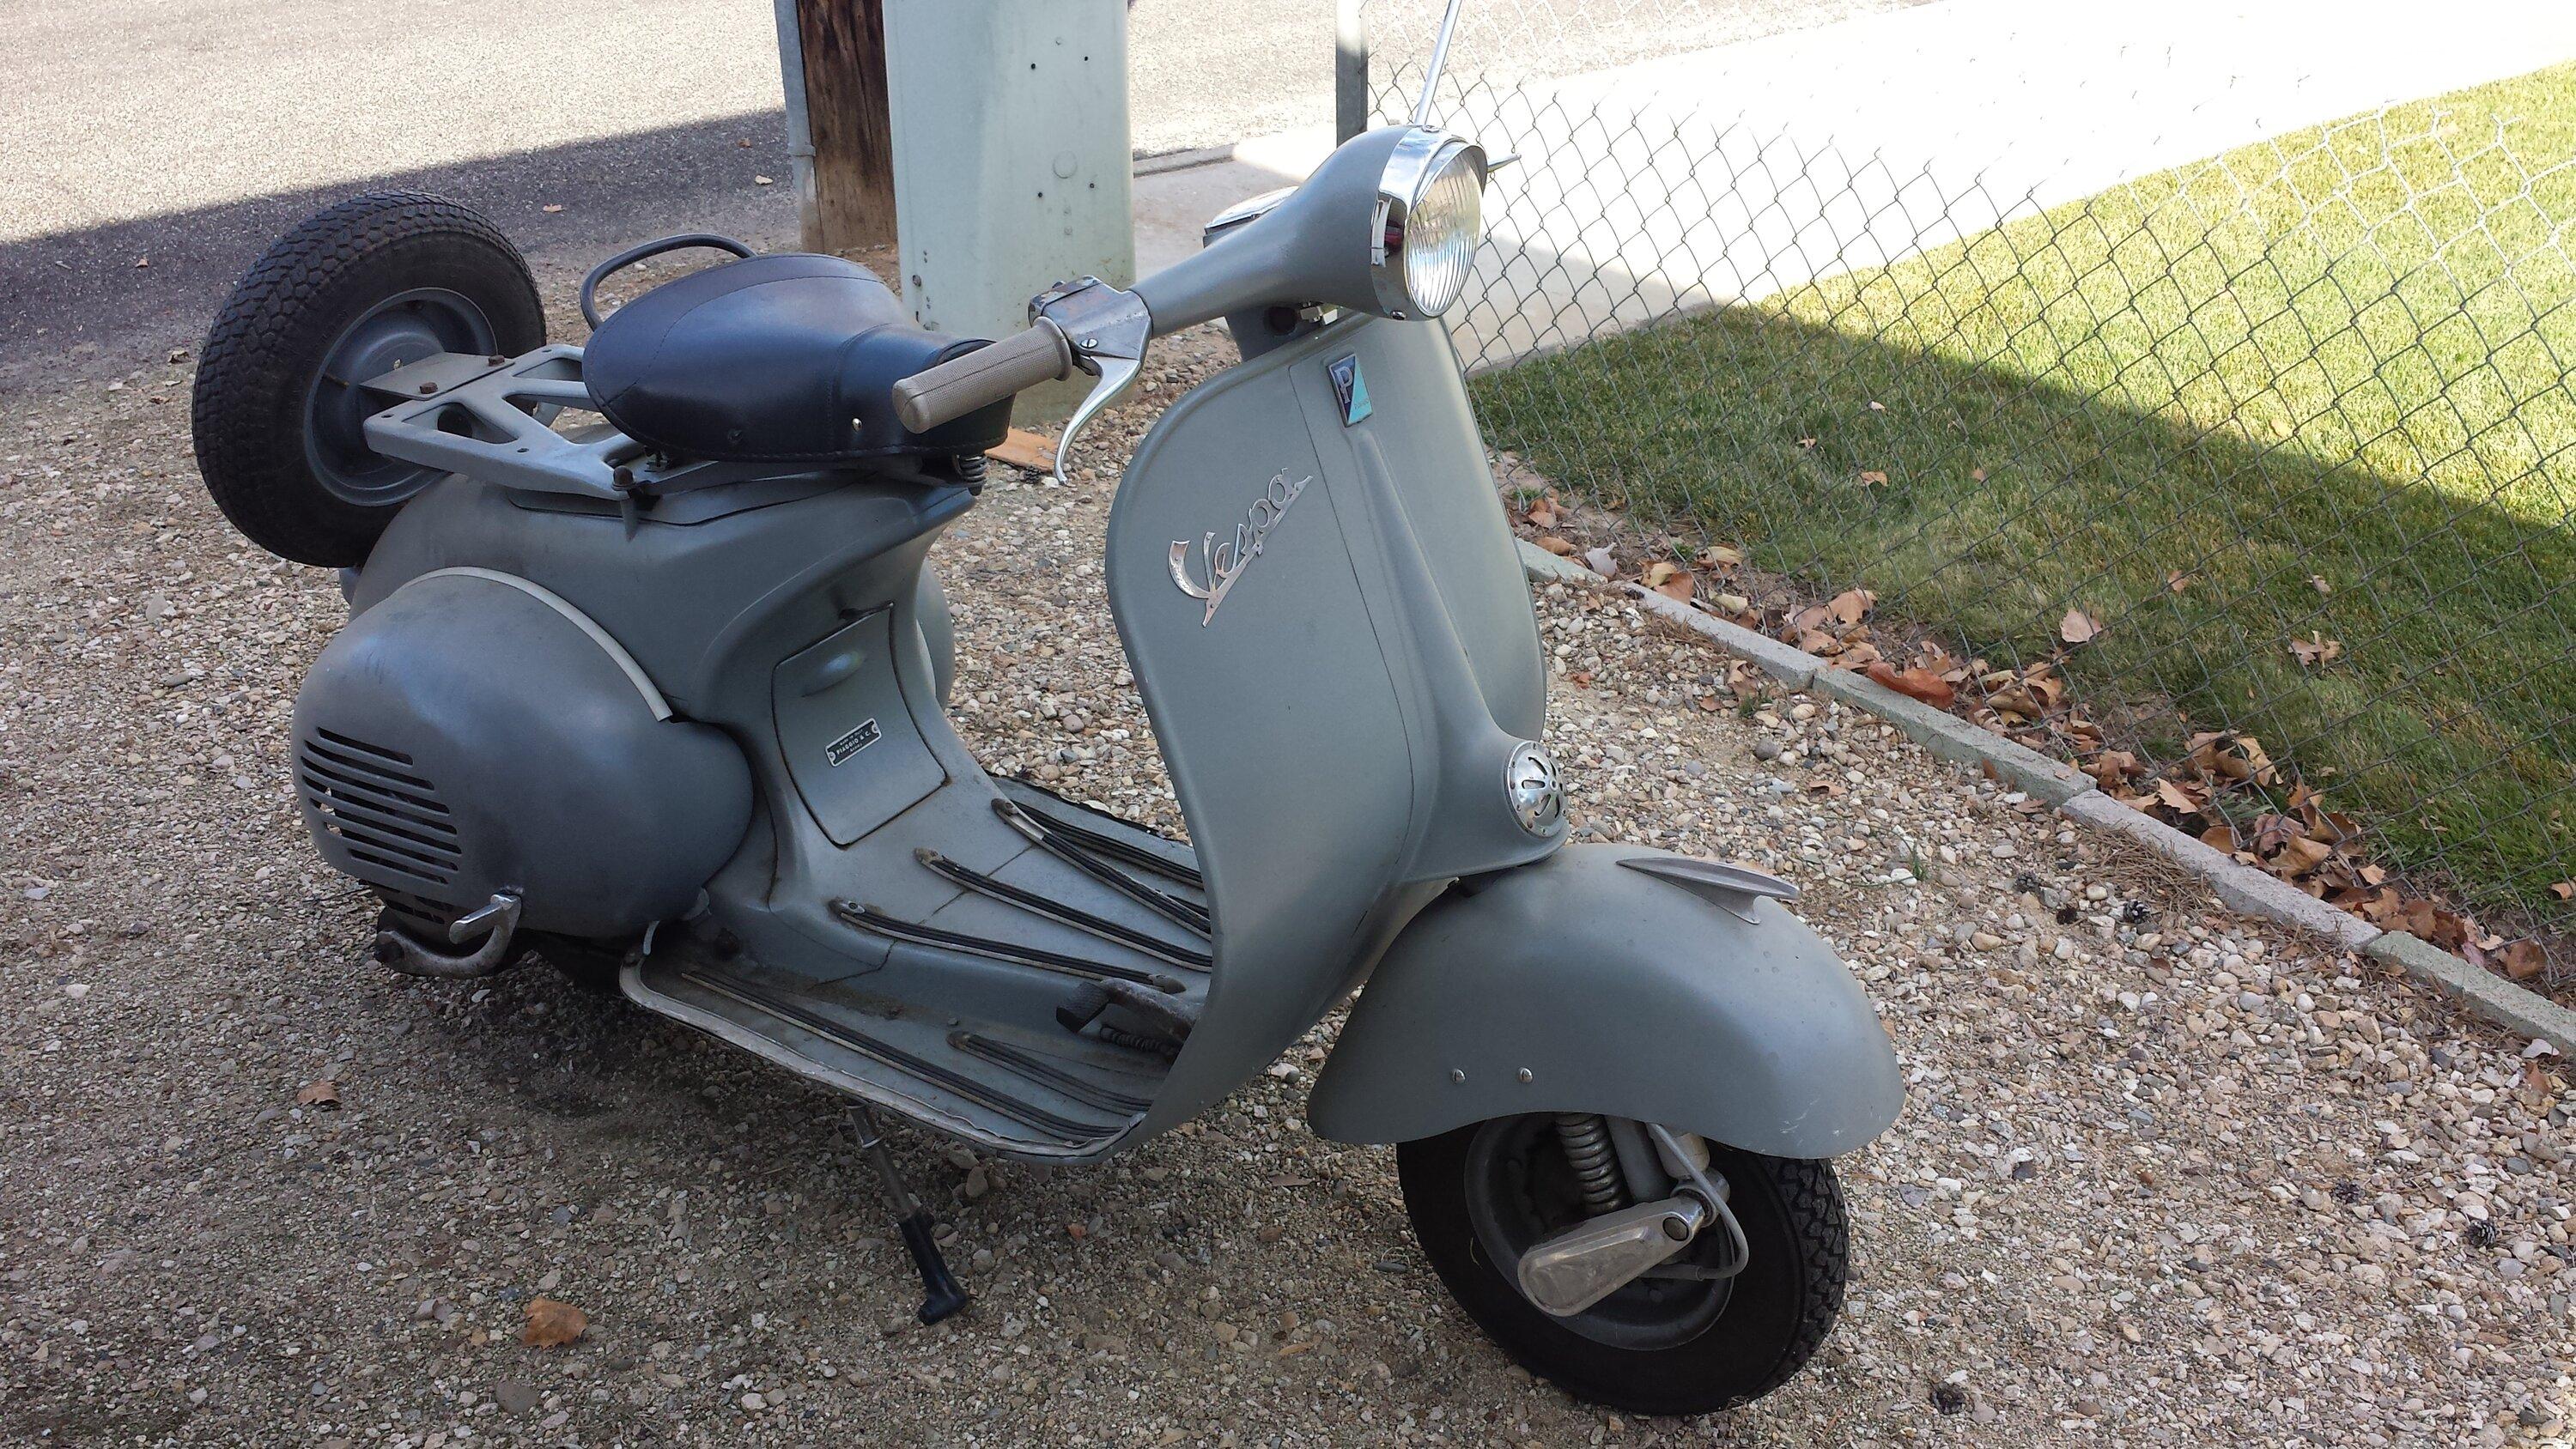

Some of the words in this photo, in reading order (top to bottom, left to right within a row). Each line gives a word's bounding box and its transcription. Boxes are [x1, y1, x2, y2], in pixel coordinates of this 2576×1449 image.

[1334, 366, 1353, 404] P
[1168, 467, 1314, 627] Vespa
[835, 737, 860, 755] PIAGGIO
